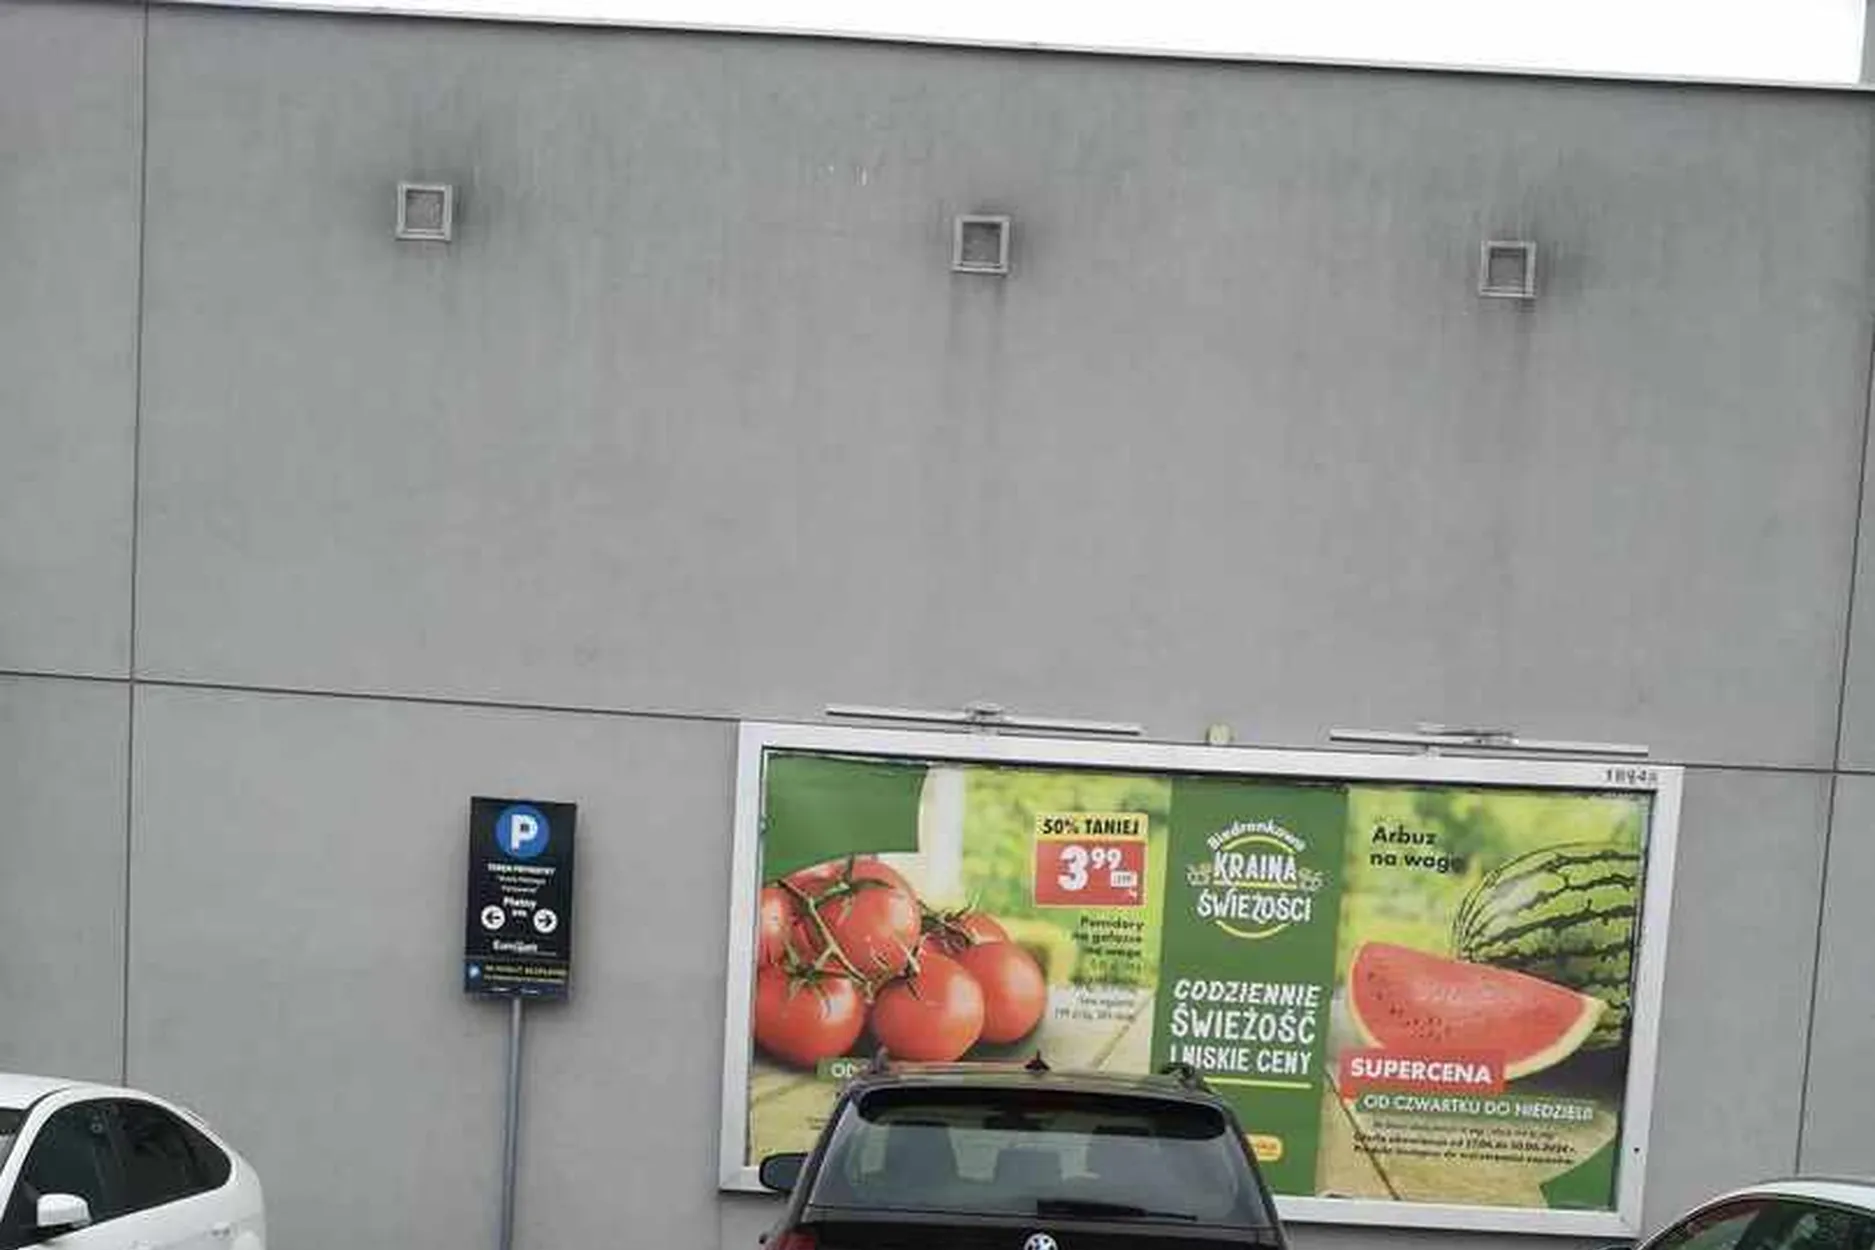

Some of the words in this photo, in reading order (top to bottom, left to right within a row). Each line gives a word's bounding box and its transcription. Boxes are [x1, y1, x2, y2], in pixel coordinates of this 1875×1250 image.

[511, 815, 538, 850] P
[1043, 818, 1078, 834] 50%
[1086, 819, 1138, 835] TANIEJ
[1372, 824, 1436, 844] Arbuz
[1214, 852, 1296, 888] KRAINA
[1370, 854, 1396, 866] na
[1174, 978, 1321, 1007] CODZIENNIE
[1170, 1002, 1315, 1044] ŚWIEŻOŚĆ
[1170, 1044, 1176, 1063] I
[1182, 1045, 1249, 1071] NISKIE
[1257, 1048, 1312, 1075] CENY
[1351, 1058, 1492, 1084] SUPERCENA
[1364, 1094, 1390, 1109] OD
[1394, 1095, 1480, 1114] CZWARTKU
[1485, 1102, 1510, 1116] DO
